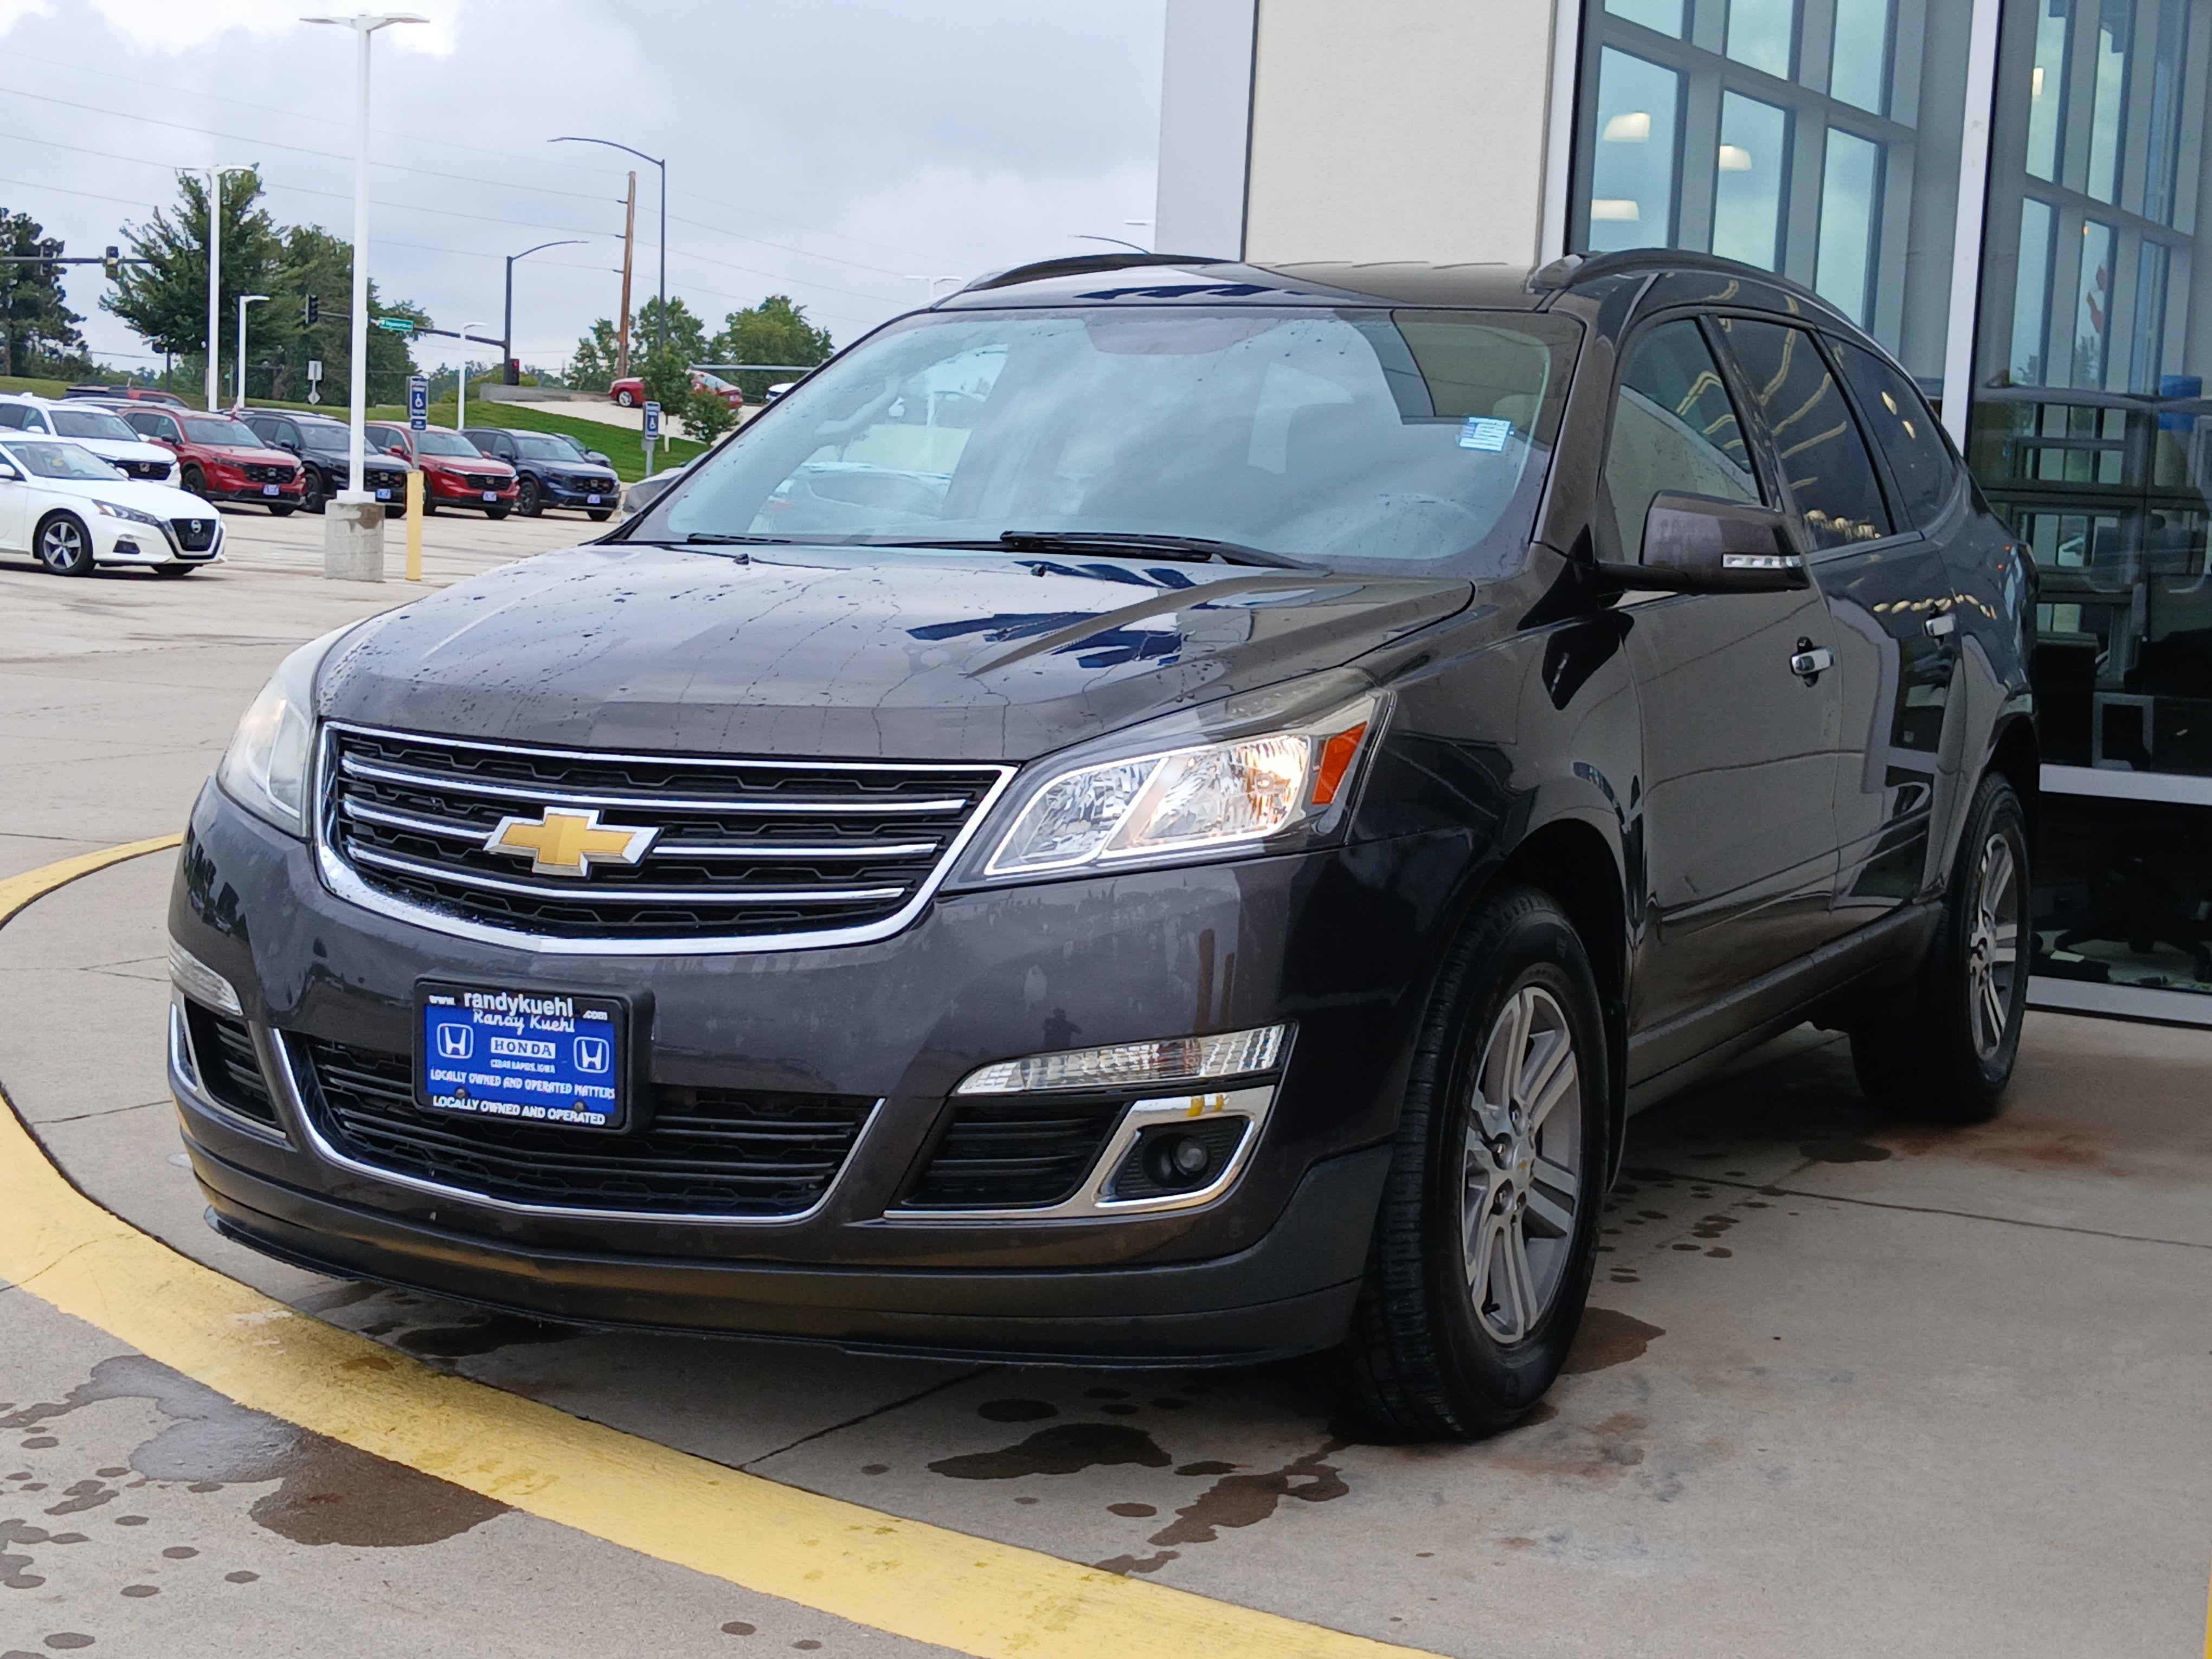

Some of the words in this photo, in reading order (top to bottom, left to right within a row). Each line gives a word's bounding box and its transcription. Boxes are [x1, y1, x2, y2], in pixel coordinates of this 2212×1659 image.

[464, 992, 574, 1018] randykuehl
[473, 1008, 525, 1036] Randy
[530, 1014, 575, 1033] Kuehl
[494, 1039, 552, 1057] HONDA
[430, 1069, 467, 1084] LOCALLY
[468, 1072, 501, 1087] OWNED
[503, 1077, 523, 1089] AND
[524, 1079, 573, 1095] OPERATED
[433, 1095, 479, 1111] LOCALLY
[480, 1100, 521, 1116] OWNED
[522, 1105, 546, 1118] AND
[547, 1108, 606, 1126] OPERATED
